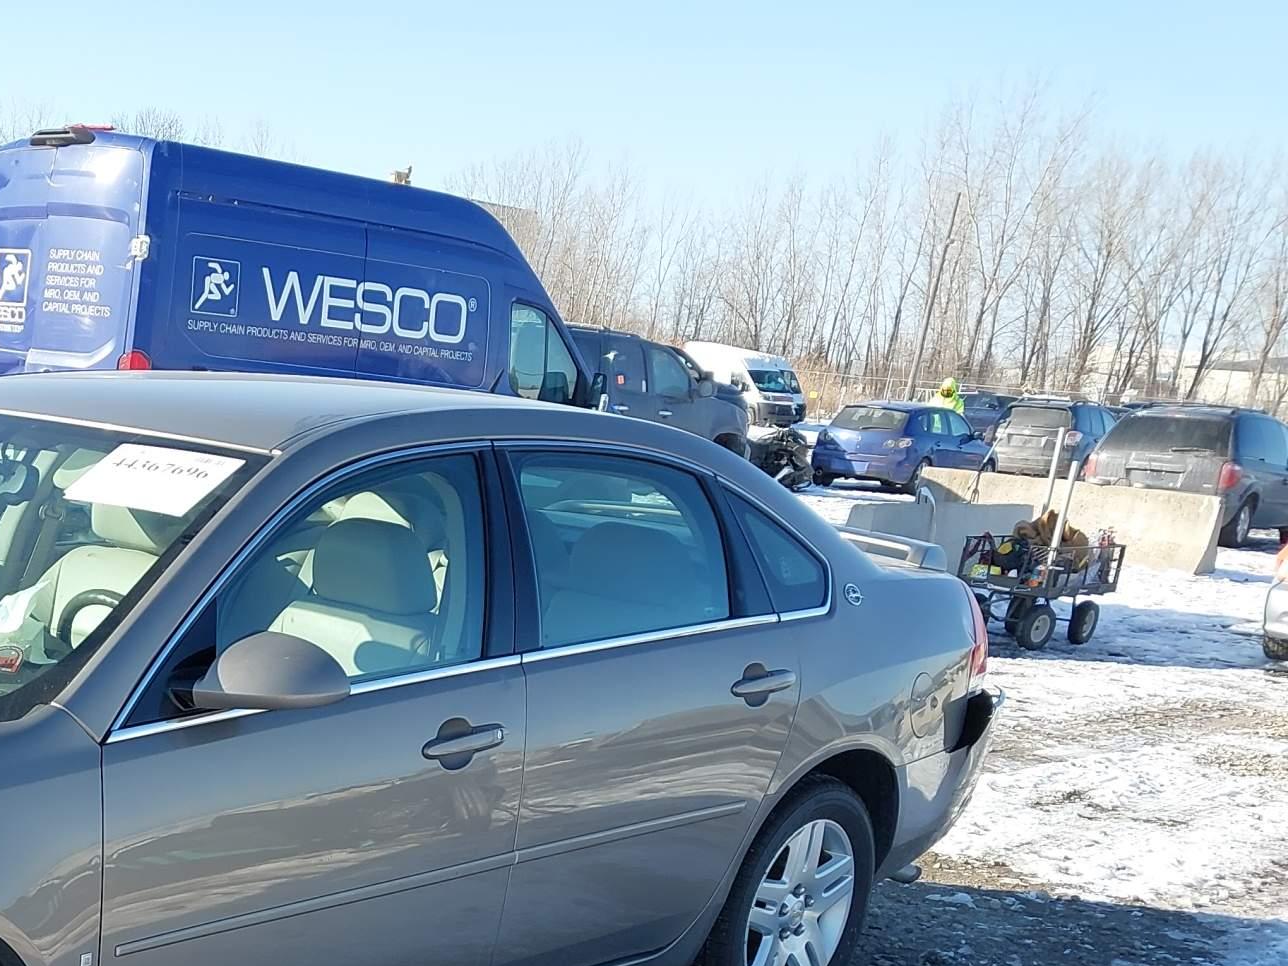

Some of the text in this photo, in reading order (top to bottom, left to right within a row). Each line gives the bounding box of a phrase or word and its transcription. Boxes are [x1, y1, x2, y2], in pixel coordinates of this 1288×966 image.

[49, 248, 100, 261] SUPPLY CHAIN
[48, 262, 104, 275] PRODUCTS AND
[46, 275, 96, 288] SERVICES FOR
[82, 291, 99, 302] AND
[42, 301, 111, 317] CAPITAL PROJECTS
[187, 319, 218, 332] SUPPLY
[219, 322, 245, 335] CHAIN
[246, 325, 289, 340] PRODUCTS
[289, 331, 306, 342] AND
[307, 333, 342, 346] SERVICES
[343, 338, 358, 348] FOR
[397, 344, 412, 354] AND
[413, 345, 440, 358] CAPITAL
[440, 349, 473, 362] PROJECTS
